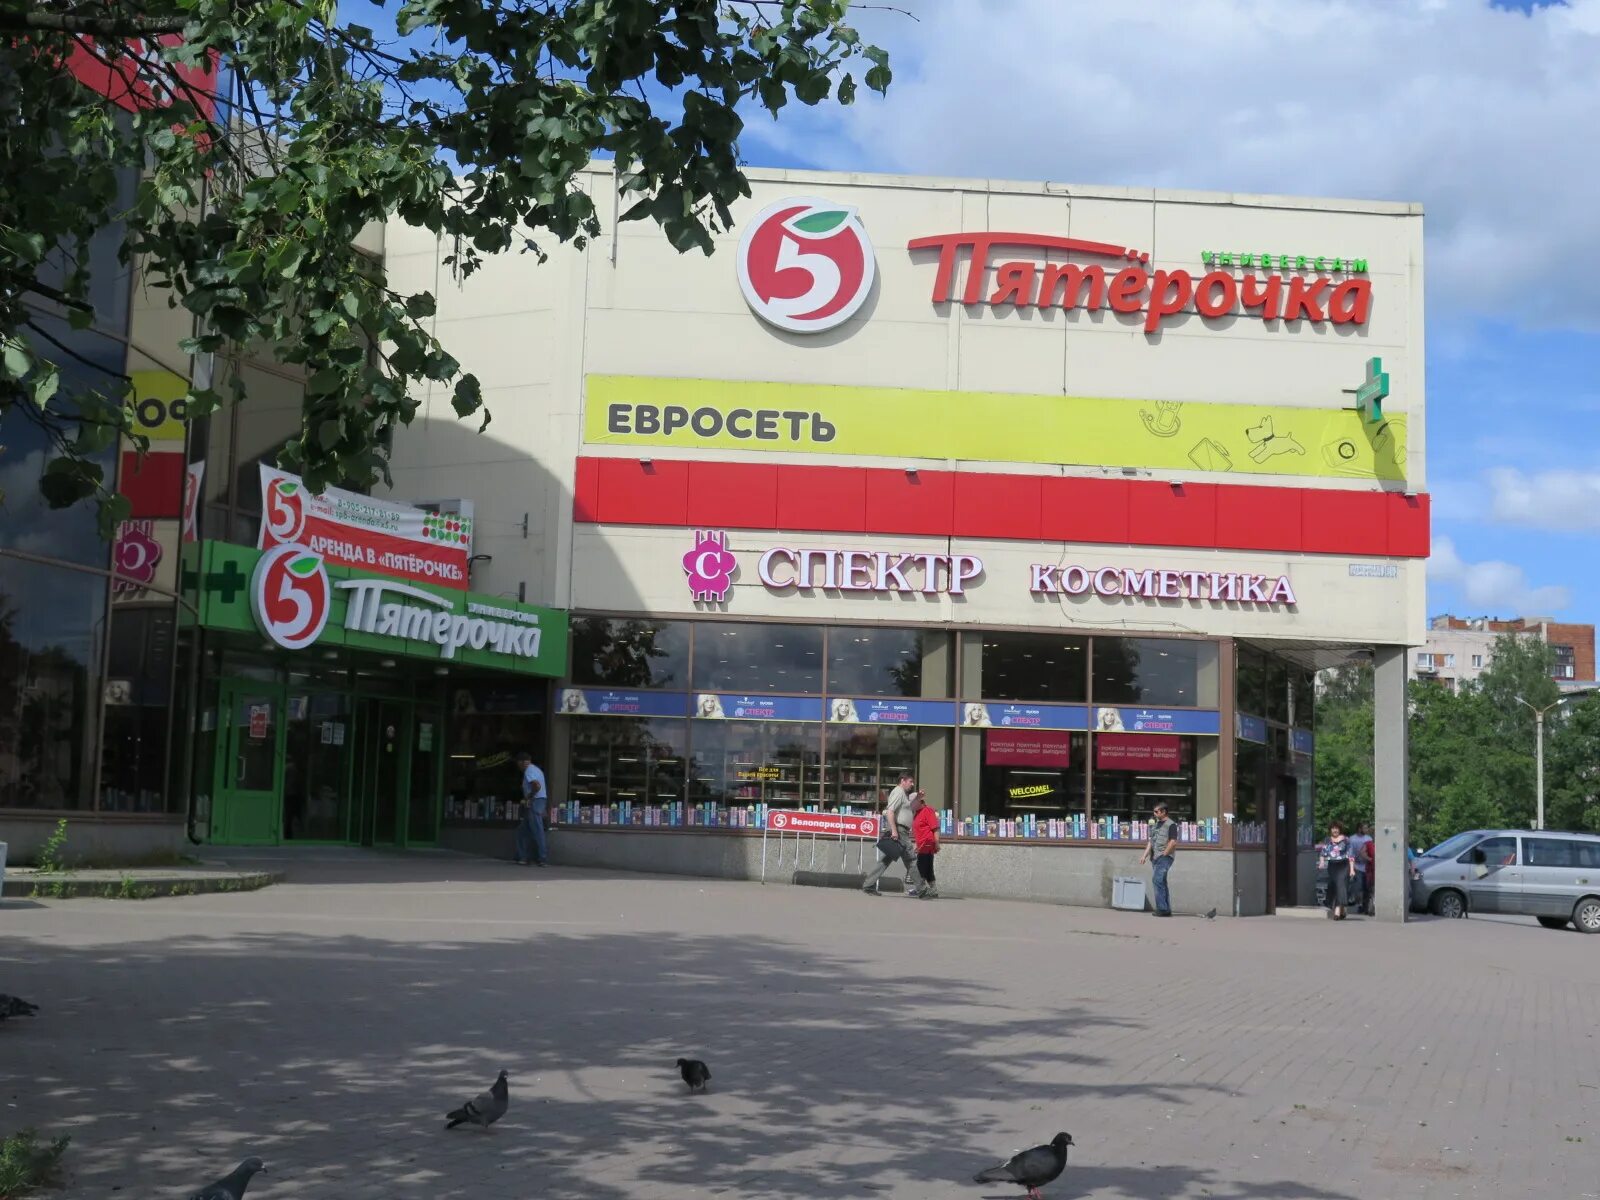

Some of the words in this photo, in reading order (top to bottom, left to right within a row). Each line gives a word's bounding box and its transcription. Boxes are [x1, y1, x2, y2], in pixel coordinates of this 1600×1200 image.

[1201, 250, 1369, 273] УНИВЕРСАМ
[608, 403, 836, 442] ЕВРОСЕТЬ
[310, 535, 365, 563] АРЕНДА
[366, 547, 376, 565] В
[758, 548, 984, 595] СПЕКТР
[1030, 564, 1297, 604] КОСМЕТИКА
[1009, 784, 1049, 796] WELCOME!
[791, 817, 857, 830] Велопарковка
